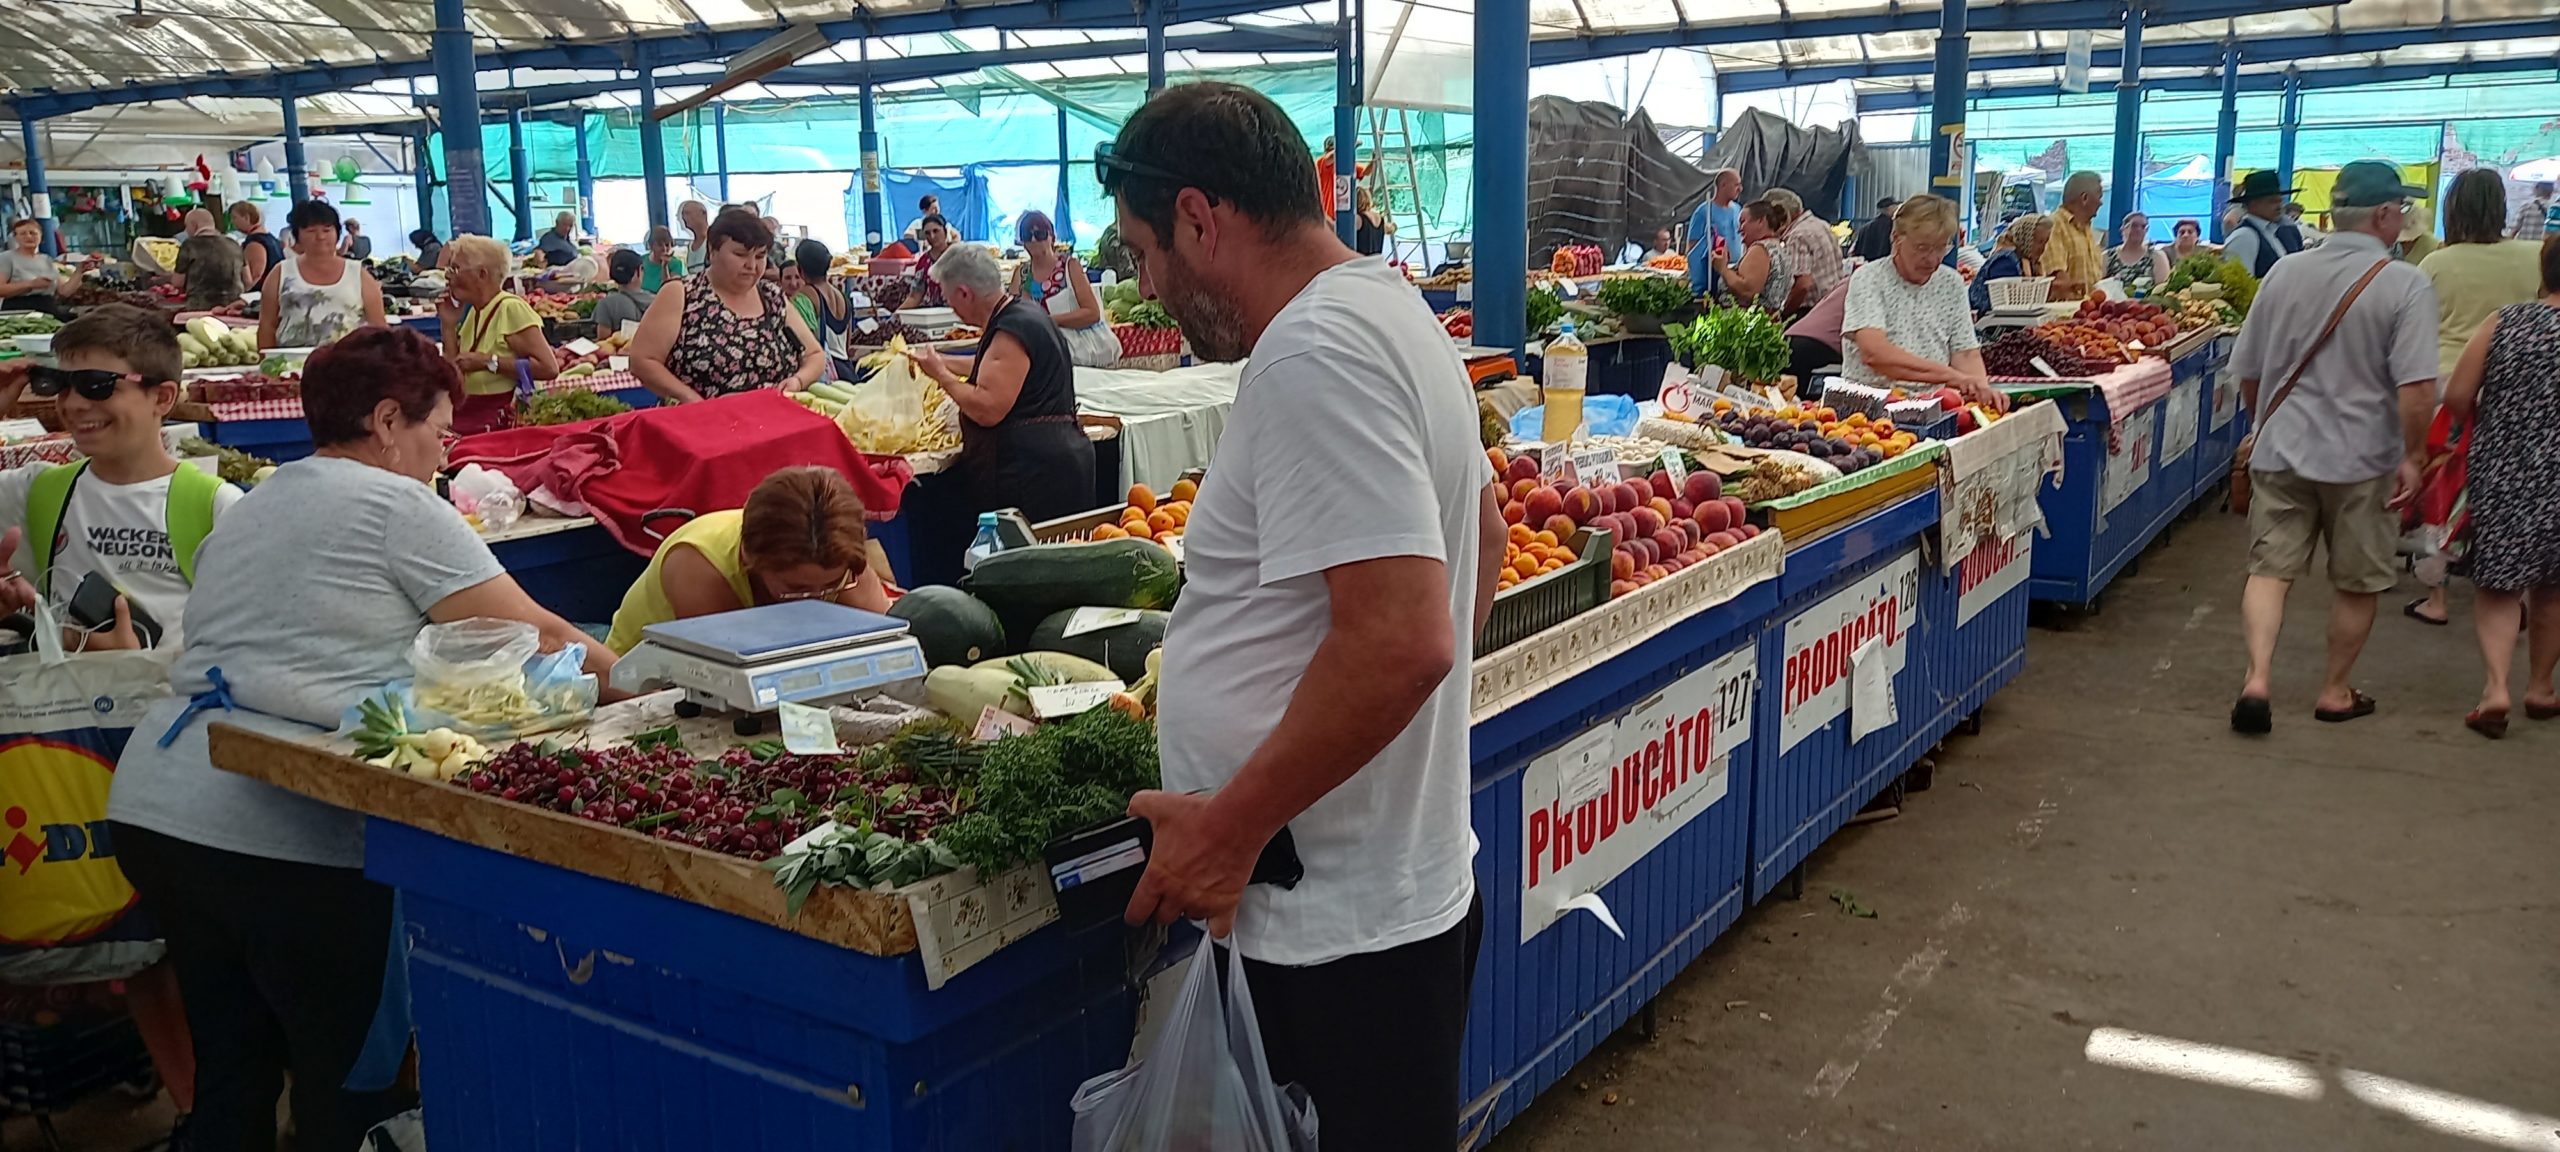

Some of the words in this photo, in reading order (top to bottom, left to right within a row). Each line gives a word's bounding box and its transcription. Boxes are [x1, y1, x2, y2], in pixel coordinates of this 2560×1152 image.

[87, 526, 171, 546] WACKER
[87, 541, 174, 559] NEUSON
[1899, 567, 1917, 616] 126
[1785, 594, 1904, 715] PRODUCĂTO
[1719, 668, 1752, 734] 127
[1529, 706, 1715, 890] PRODUCĂTO
